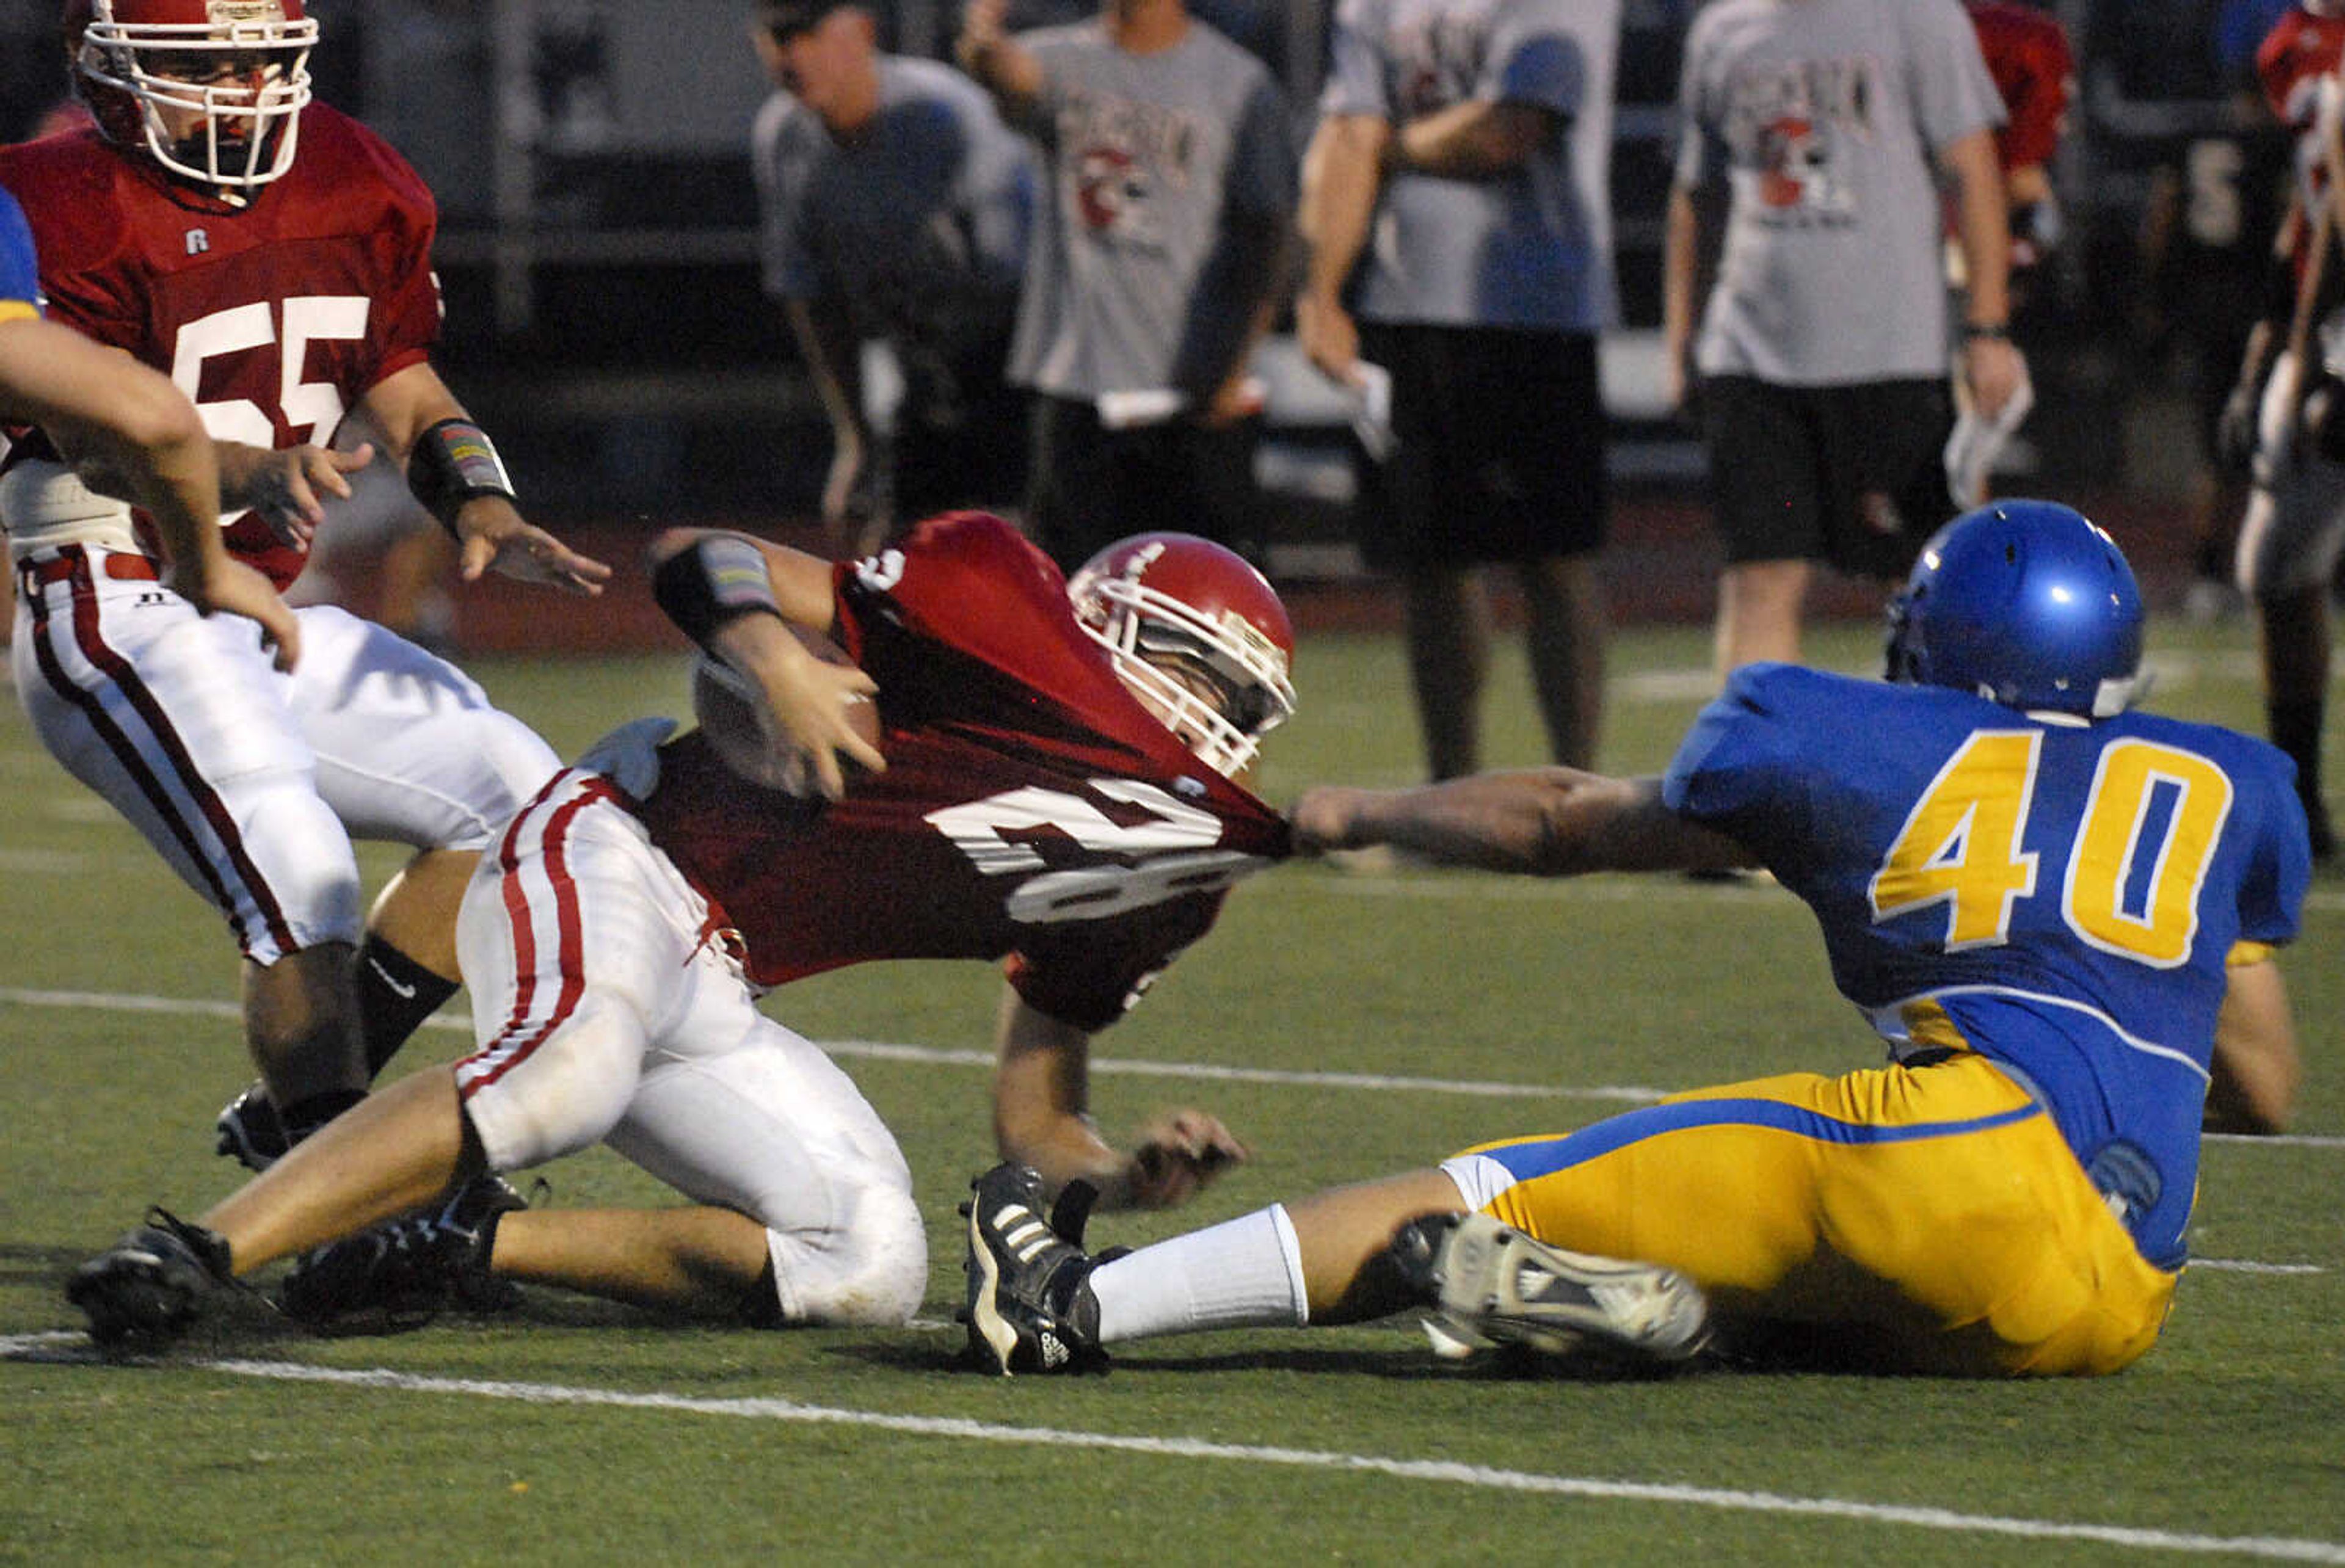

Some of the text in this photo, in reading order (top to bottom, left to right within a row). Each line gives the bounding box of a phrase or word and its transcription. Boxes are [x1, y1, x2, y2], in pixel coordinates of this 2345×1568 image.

[186, 228, 209, 254] R
[172, 296, 370, 526] 55
[1867, 730, 2234, 970] 40
